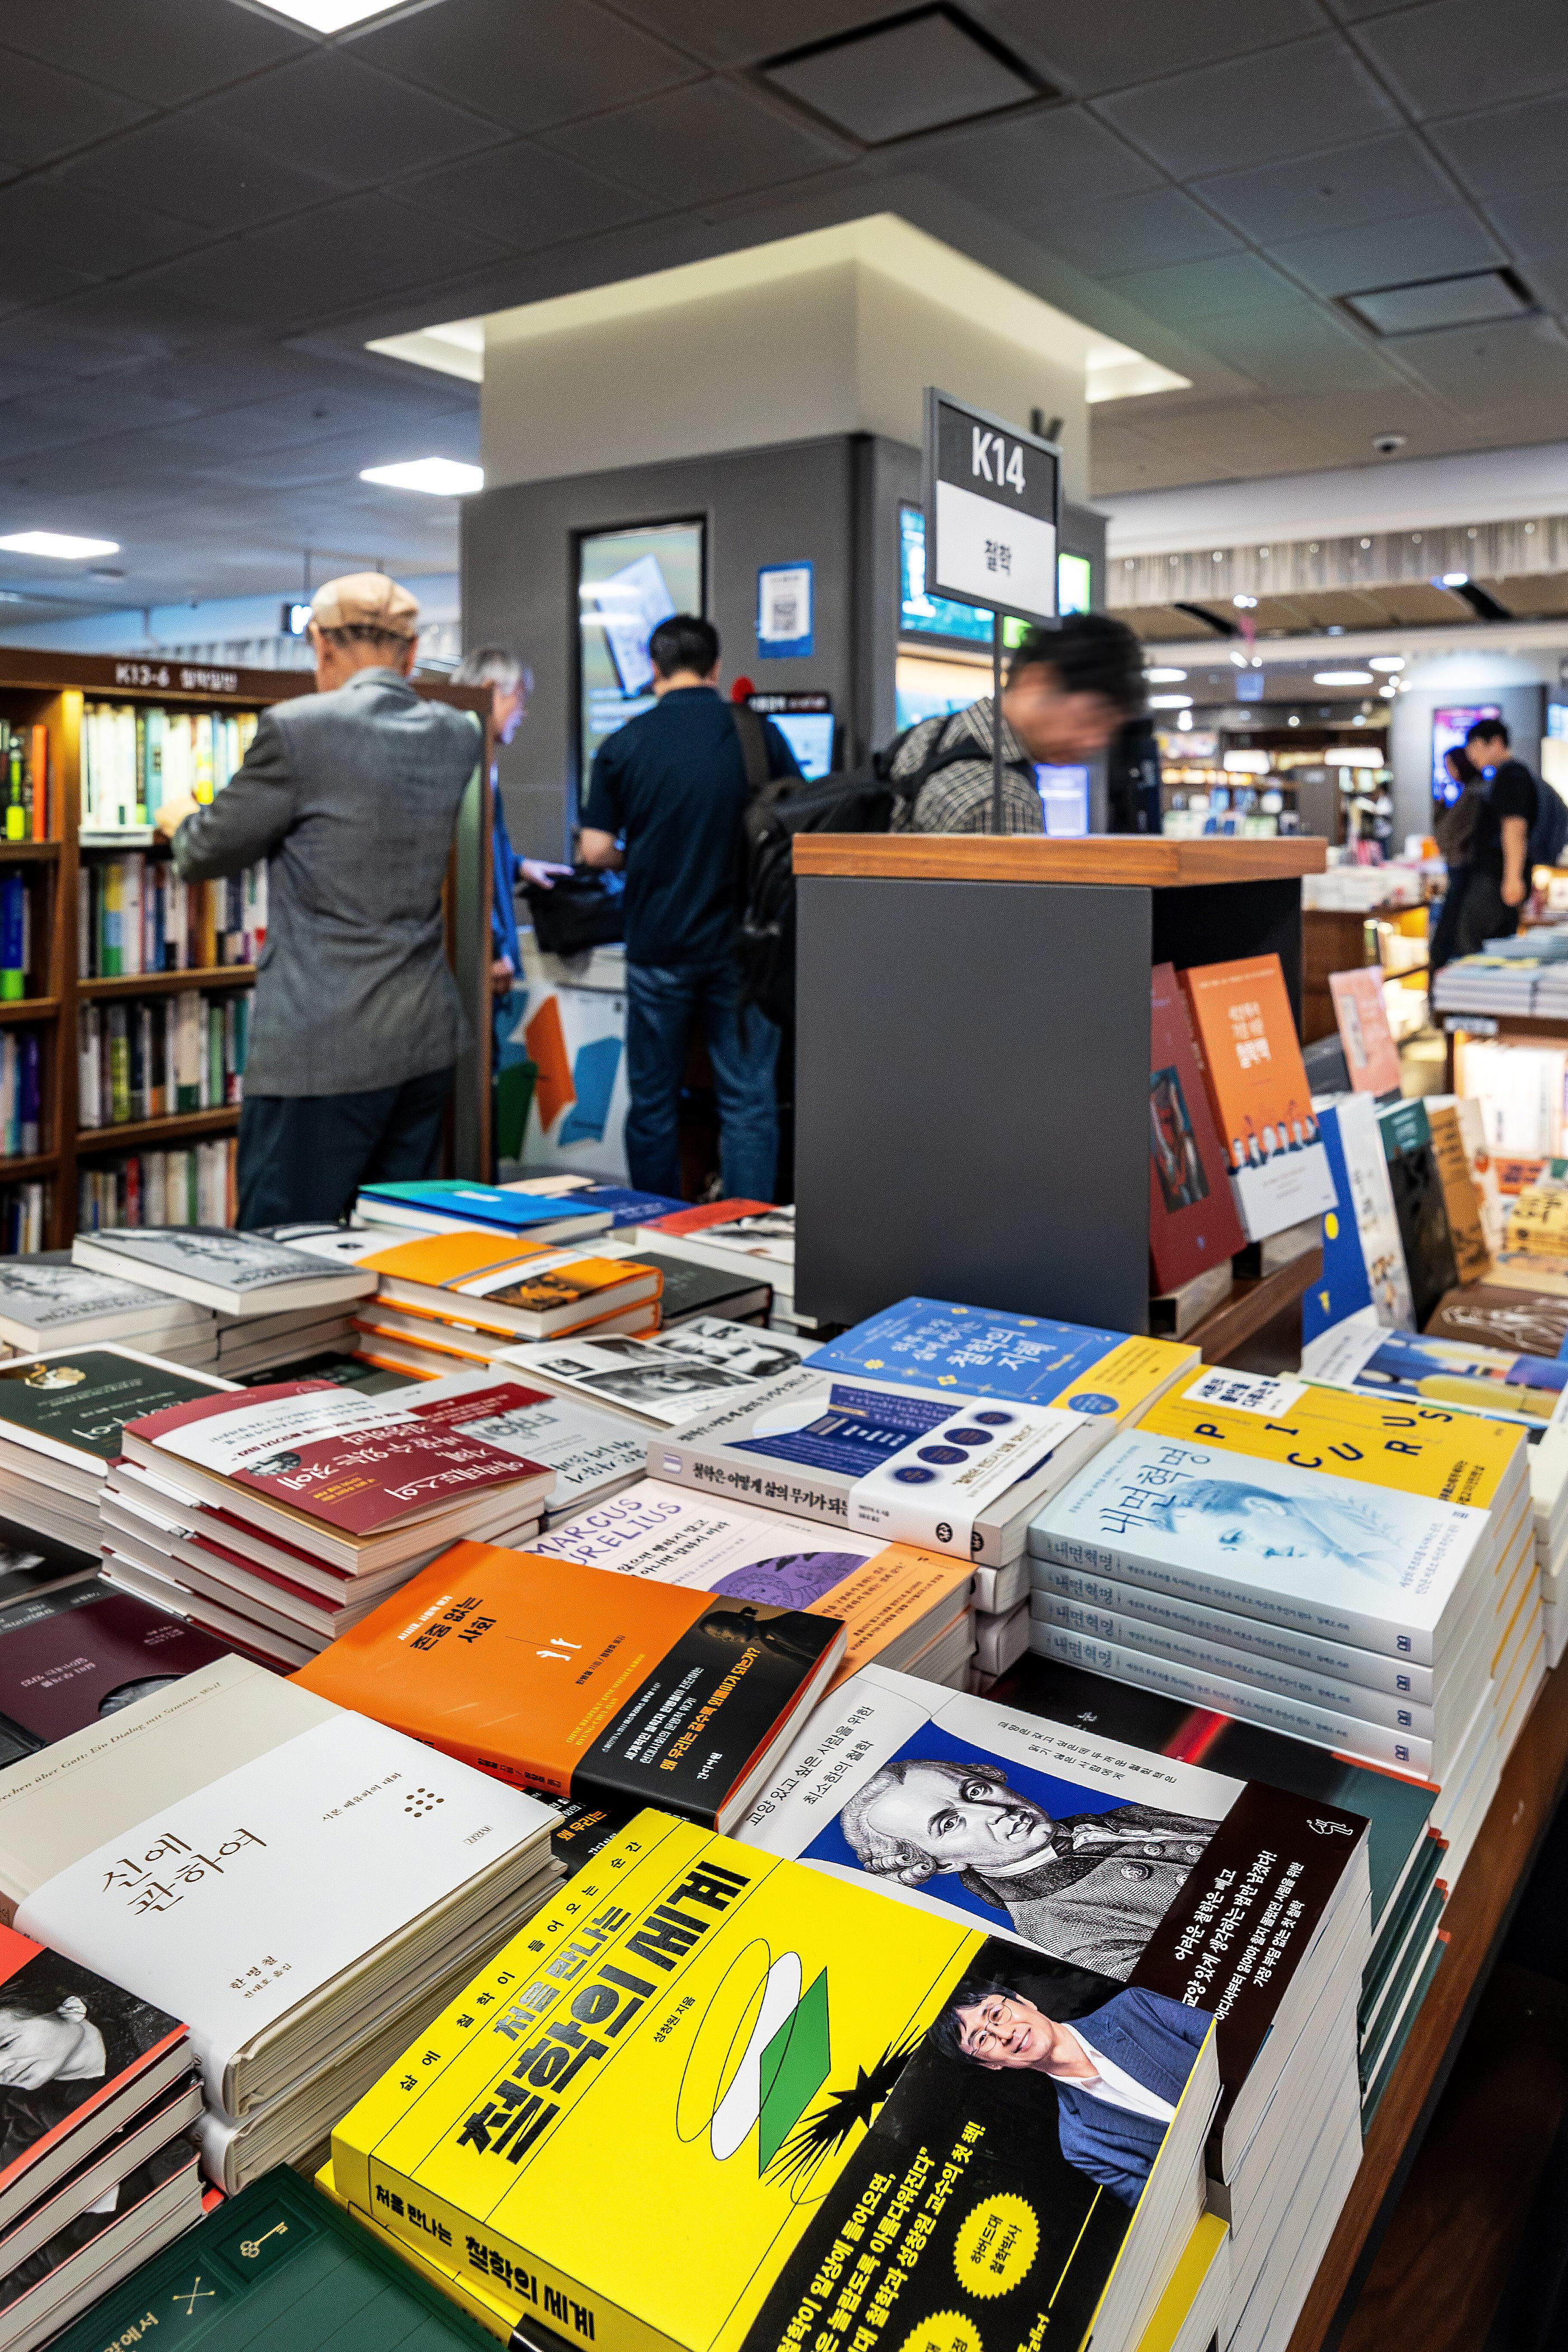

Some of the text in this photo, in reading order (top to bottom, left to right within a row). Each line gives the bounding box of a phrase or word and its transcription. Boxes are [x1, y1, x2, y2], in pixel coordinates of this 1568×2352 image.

[972, 426, 1025, 494] K14
[984, 538, 1012, 575] 철학
[945, 1326, 1026, 1369] 철학의
[997, 1340, 1058, 1371] 지혜
[332, 1447, 390, 1466] 있는
[340, 1422, 432, 1446] 집중하라
[387, 1442, 413, 1453] 수
[409, 1435, 463, 1450] 바꿀
[435, 1448, 493, 1461] 지혜,
[276, 1463, 340, 1491] 것에
[383, 1461, 524, 1501] 에픽테토스의
[693, 1462, 726, 1484] 철학은
[727, 1472, 762, 1494] 어떻게
[765, 1482, 789, 1502] 삶의
[790, 1488, 826, 1510] 무기가
[1099, 1446, 1211, 1534] 내면혁명
[524, 1498, 642, 1554] MARCUS
[566, 1502, 682, 1565] URELIUS
[617, 1552, 655, 1572] 않으면
[652, 1530, 685, 1554] 행하지
[683, 1519, 710, 1534] 말고
[641, 1551, 678, 1575] 아니면
[673, 1534, 708, 1555] 말하지
[706, 1520, 731, 1536] 마라
[1055, 1541, 1112, 1572] 내면혁명
[1055, 1574, 1112, 1605] 내면혁명
[410, 1597, 484, 1650] 존중 없는
[458, 1617, 497, 1643] 사회
[1055, 1606, 1114, 1637] 내면혁명
[1054, 1636, 1111, 1668] 내면혁명
[623, 1667, 704, 1760] 세계적인 철학자 한병철이 진단하는
[660, 1646, 761, 1772] 왜 우리는 갈수록 외톨이가 되는가?
[0, 1682, 222, 1802] echen über Gott: Ein Dialog mit Simone Weil
[639, 1730, 671, 1764] 현대사회의
[665, 1711, 686, 1731] 문명적
[998, 1721, 1178, 1783] 교양은 갖고 싶은데 두꺼운 철학책은
[1028, 1744, 1126, 1781] 읽기 싫은 사람에게
[697, 1752, 723, 1780] 간디서원
[746, 1706, 875, 1826] 교양 있고 싶은 사람을 위한
[803, 1740, 875, 1805] 최소한의 철학
[323, 1772, 402, 1821] 시몬 베유와의 대화
[557, 1828, 576, 1841] 왜
[570, 1810, 608, 1836] 우리는
[102, 1832, 193, 1893] 신에
[128, 1828, 268, 1915] 관하여
[1174, 1869, 1237, 1962] 어려운 철학은 빼고
[1181, 1851, 1278, 2008] 교양 있게 생각하는 법만 남겼다!
[1215, 1862, 1304, 2020] 어디서부터 읽어야 할지 몰랐던 사람을 위한
[1253, 1900, 1305, 1987] 가장 부담 없는 첫 철학
[243, 1962, 293, 1999] 전대호 옮김
[494, 1905, 632, 2041] 처음 만나는
[456, 1964, 657, 2165] 철학의
[625, 1860, 752, 1972] 세계
[652, 1996, 696, 2044] 성창원 지음
[951, 2144, 974, 2162] 첫
[960, 2121, 987, 2143] 책!
[925, 2161, 964, 2217] 교수의
[810, 2242, 854, 2295] 일상에
[841, 2172, 896, 2241] 들어오면,
[814, 2146, 935, 2352] 은 놀랍도록 아름다워진다”
[899, 2212, 937, 2266] 성창원
[971, 2214, 1003, 2264] 하버드대
[990, 2223, 1022, 2275] 철학박사
[376, 2184, 595, 2341] 처음 만나는 철학의 세계
[865, 2266, 908, 2328] 철학과
